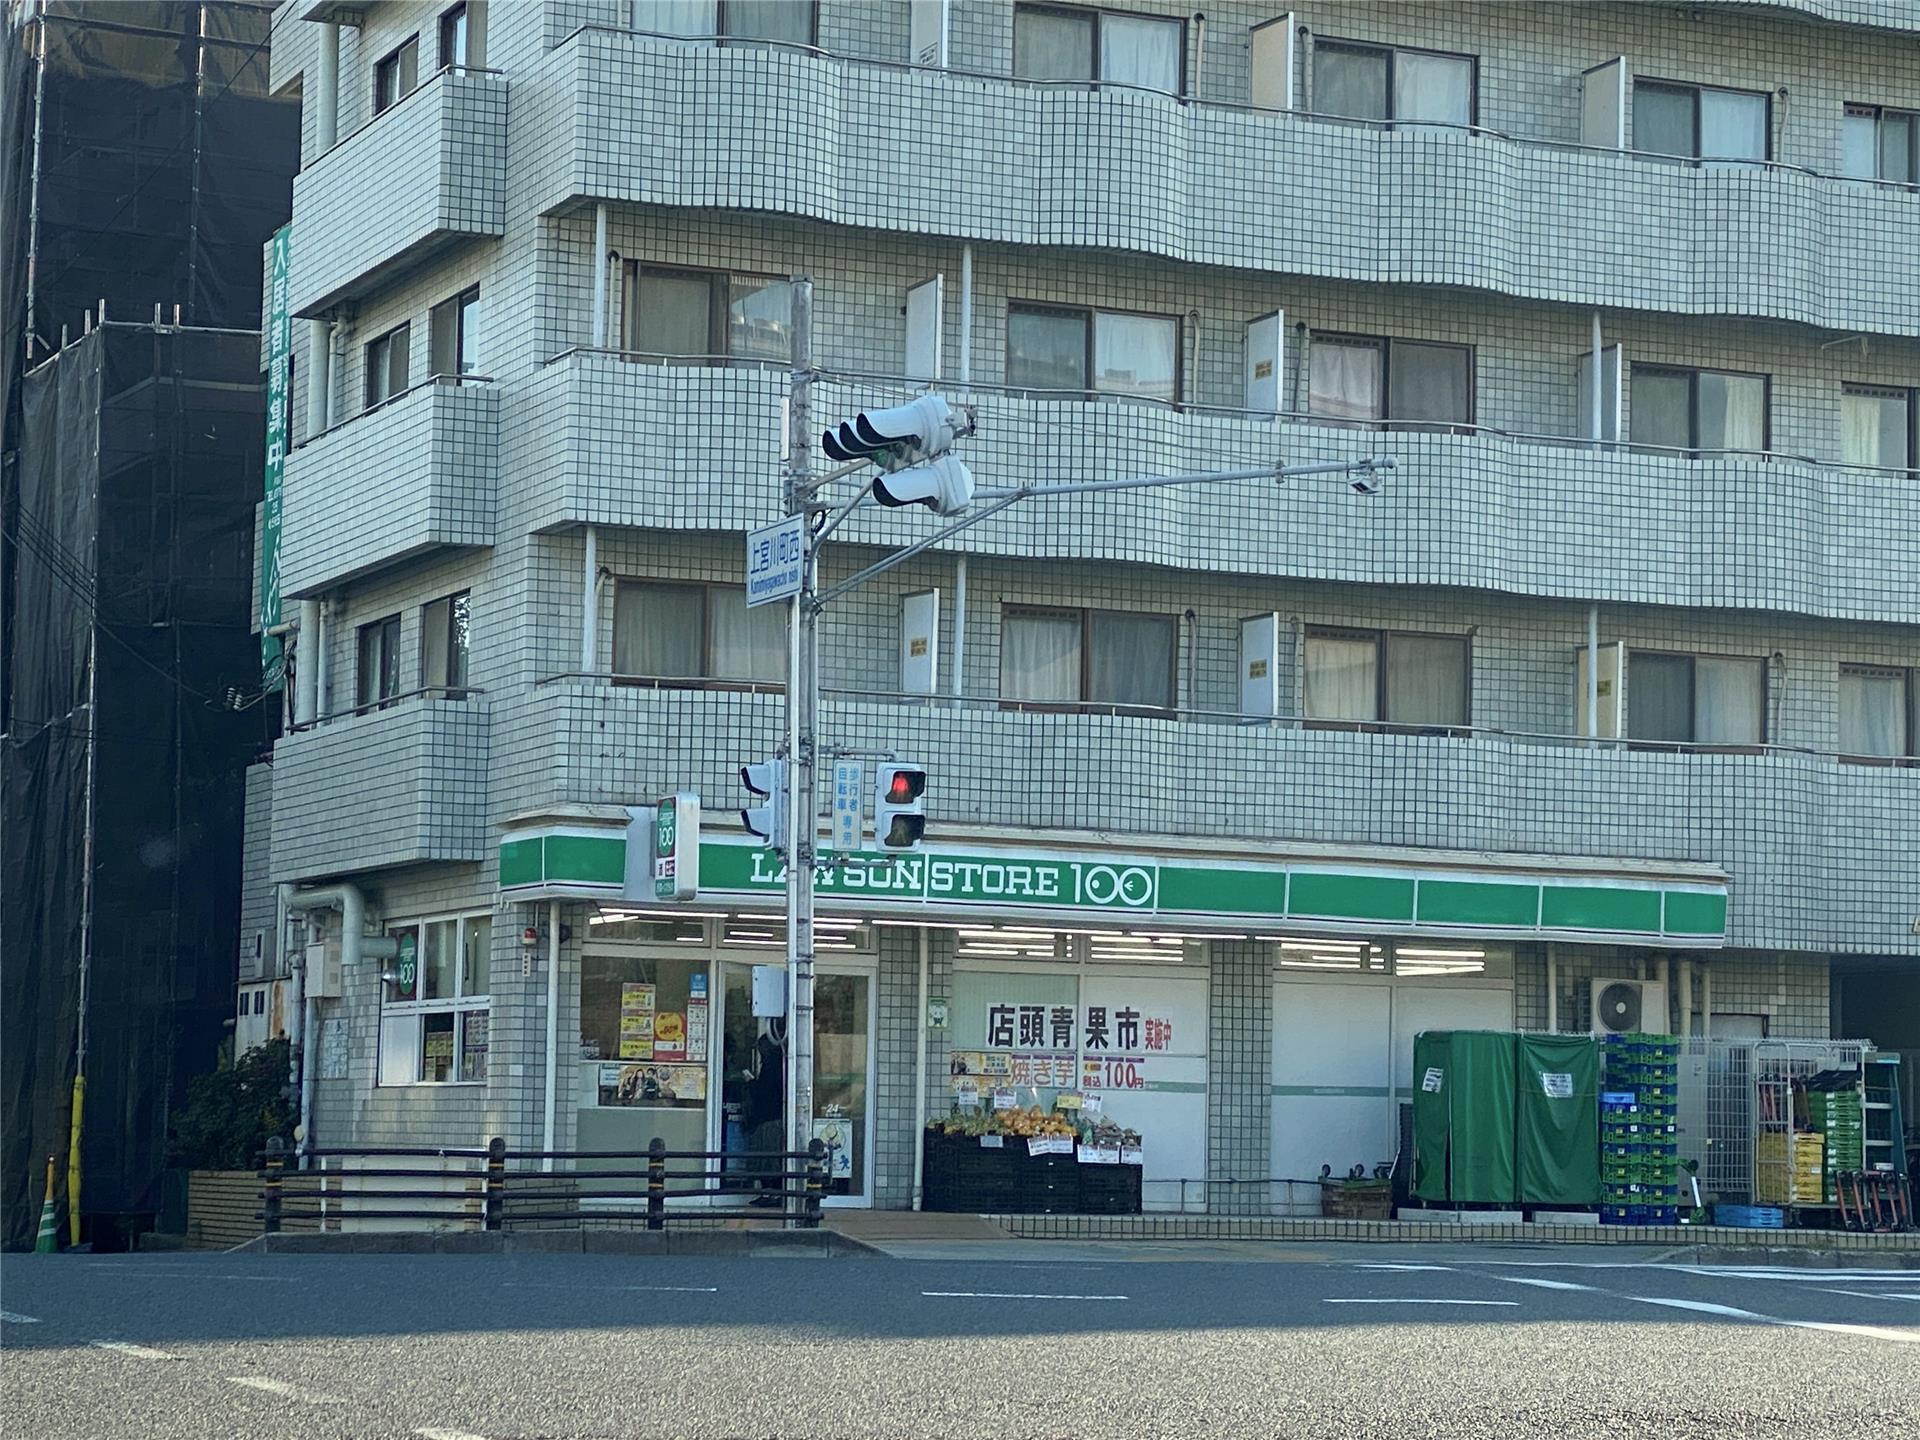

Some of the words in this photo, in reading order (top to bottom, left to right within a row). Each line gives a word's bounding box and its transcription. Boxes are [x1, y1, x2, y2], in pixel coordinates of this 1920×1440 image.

[267, 238, 286, 471] 入居者募集中
[751, 529, 799, 574] 上宮川町西
[849, 768, 859, 812] 歩行者
[931, 862, 1059, 896] STORE
[1071, 863, 1153, 906] 100
[988, 1004, 1140, 1049] 店頭青果市
[1012, 1061, 1073, 1086] 焼き芋
[1105, 1062, 1144, 1088] 100円
